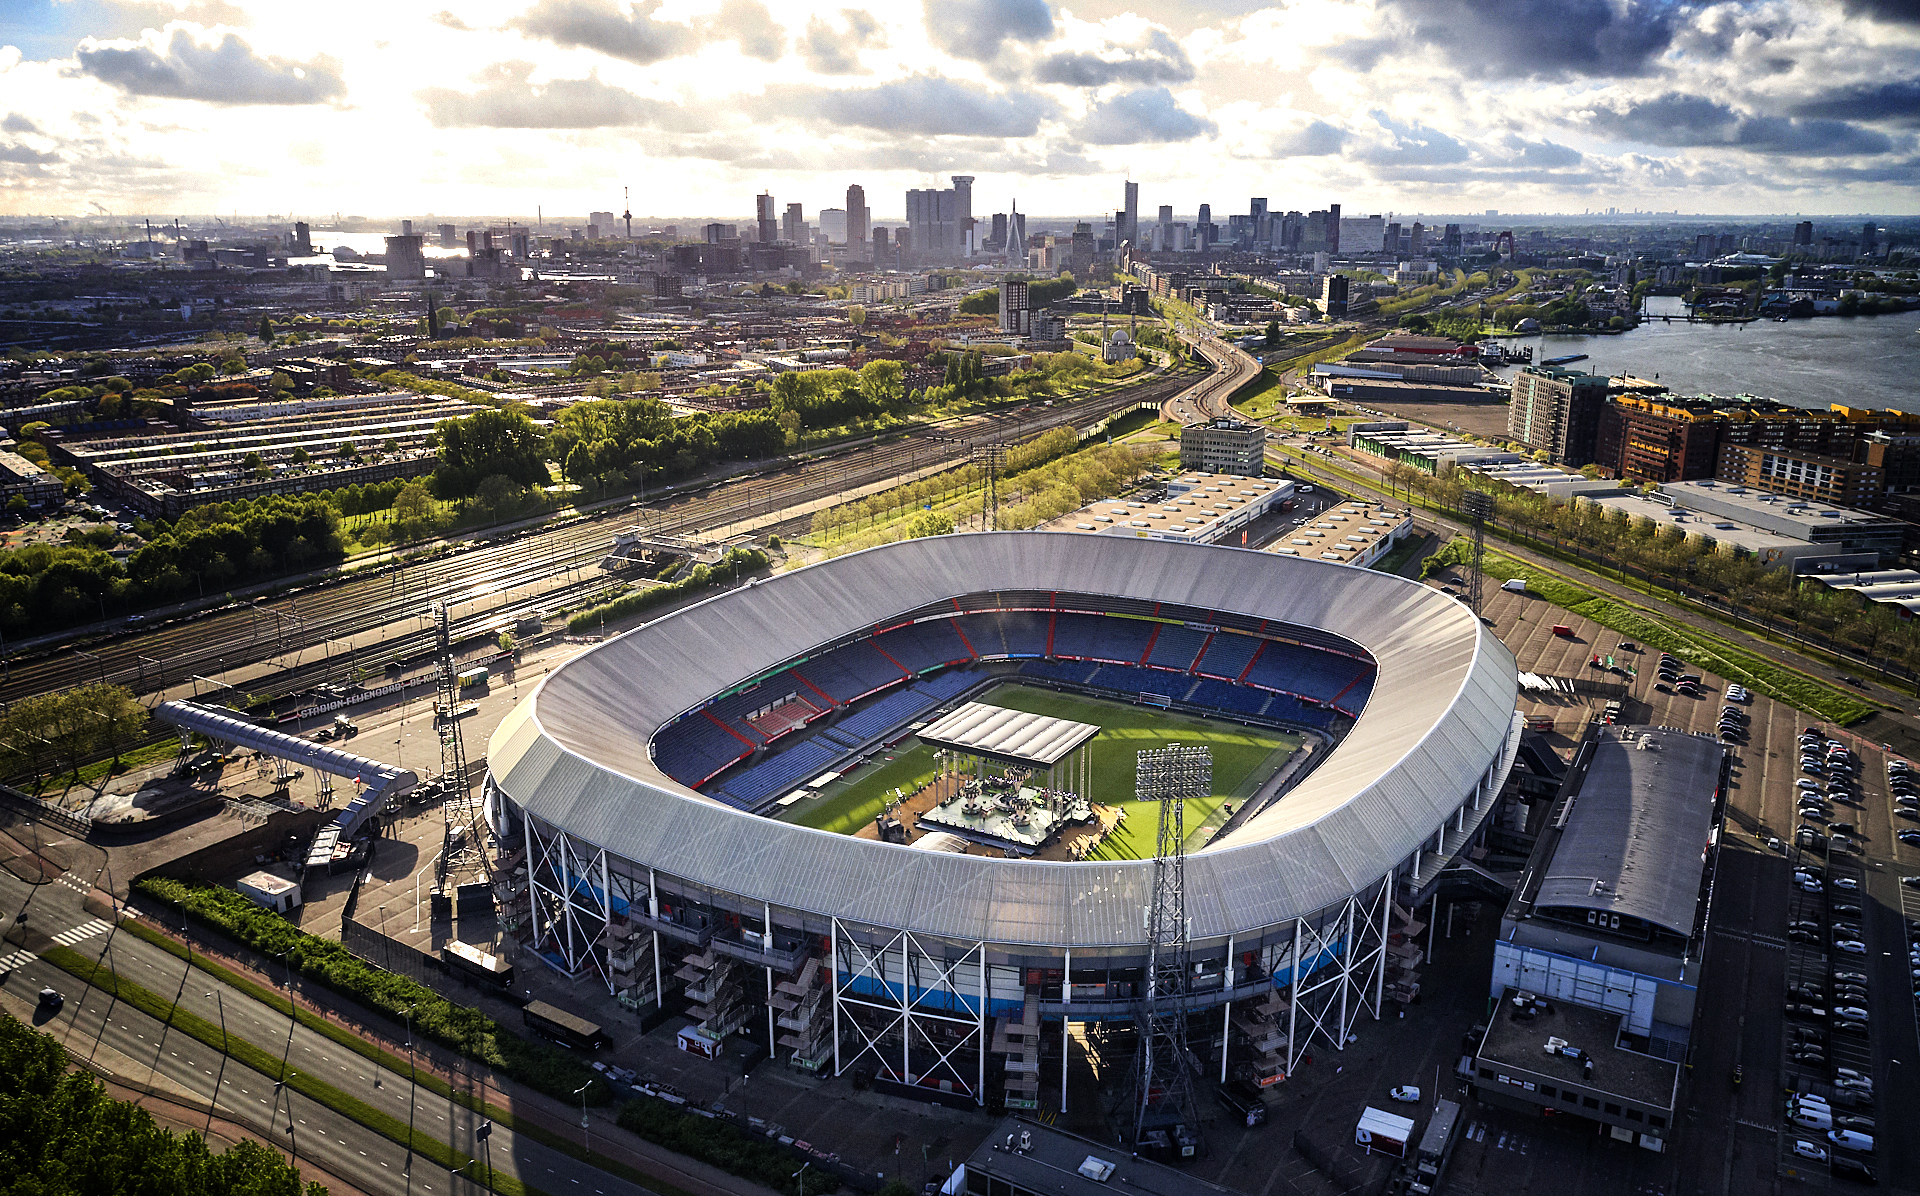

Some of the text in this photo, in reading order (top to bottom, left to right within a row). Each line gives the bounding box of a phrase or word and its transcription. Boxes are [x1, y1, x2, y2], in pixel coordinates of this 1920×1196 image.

[301, 700, 344, 719] STADION
[346, 683, 401, 706] FEIJENOORD
[479, 655, 498, 667] 1937
